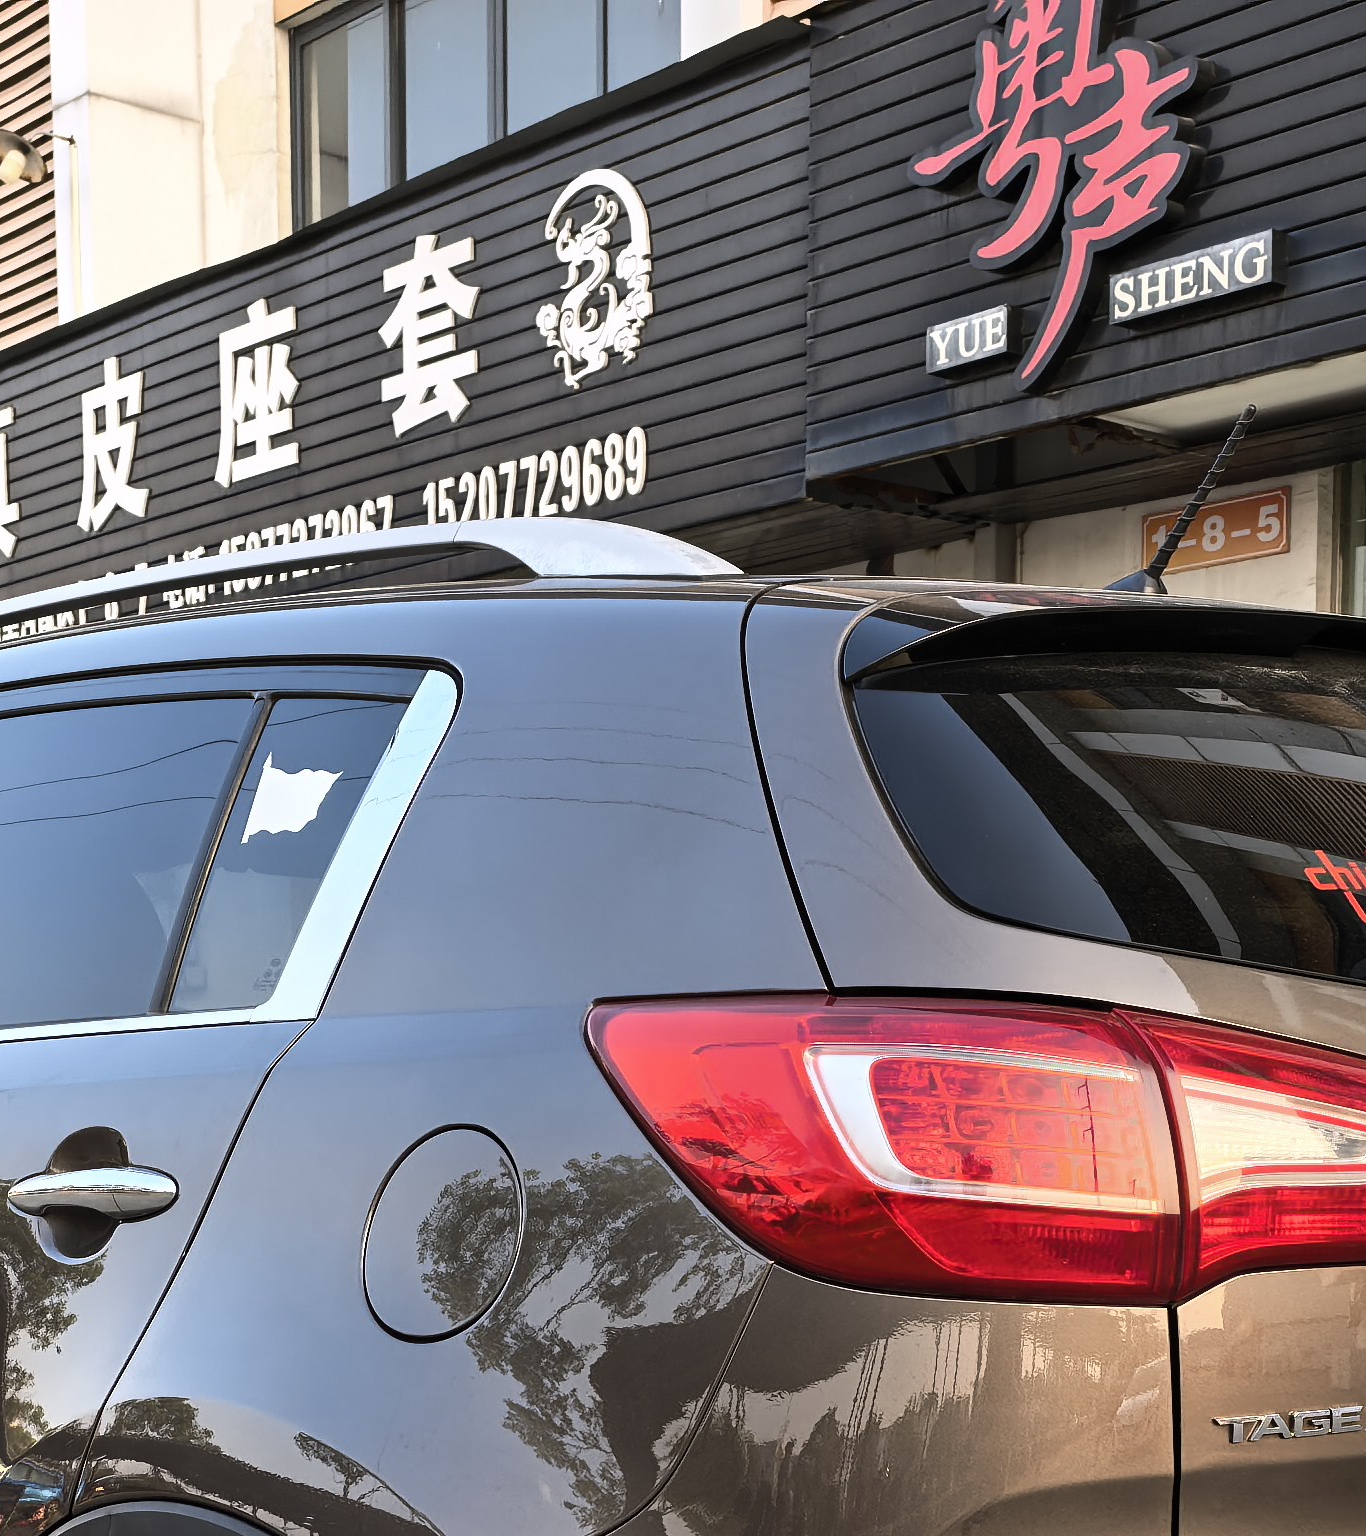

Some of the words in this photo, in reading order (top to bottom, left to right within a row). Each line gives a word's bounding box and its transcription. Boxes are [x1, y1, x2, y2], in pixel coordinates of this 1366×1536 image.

[930, 311, 1007, 365] YUE
[1113, 239, 1269, 320] SHENG
[422, 426, 647, 525] 15207729689
